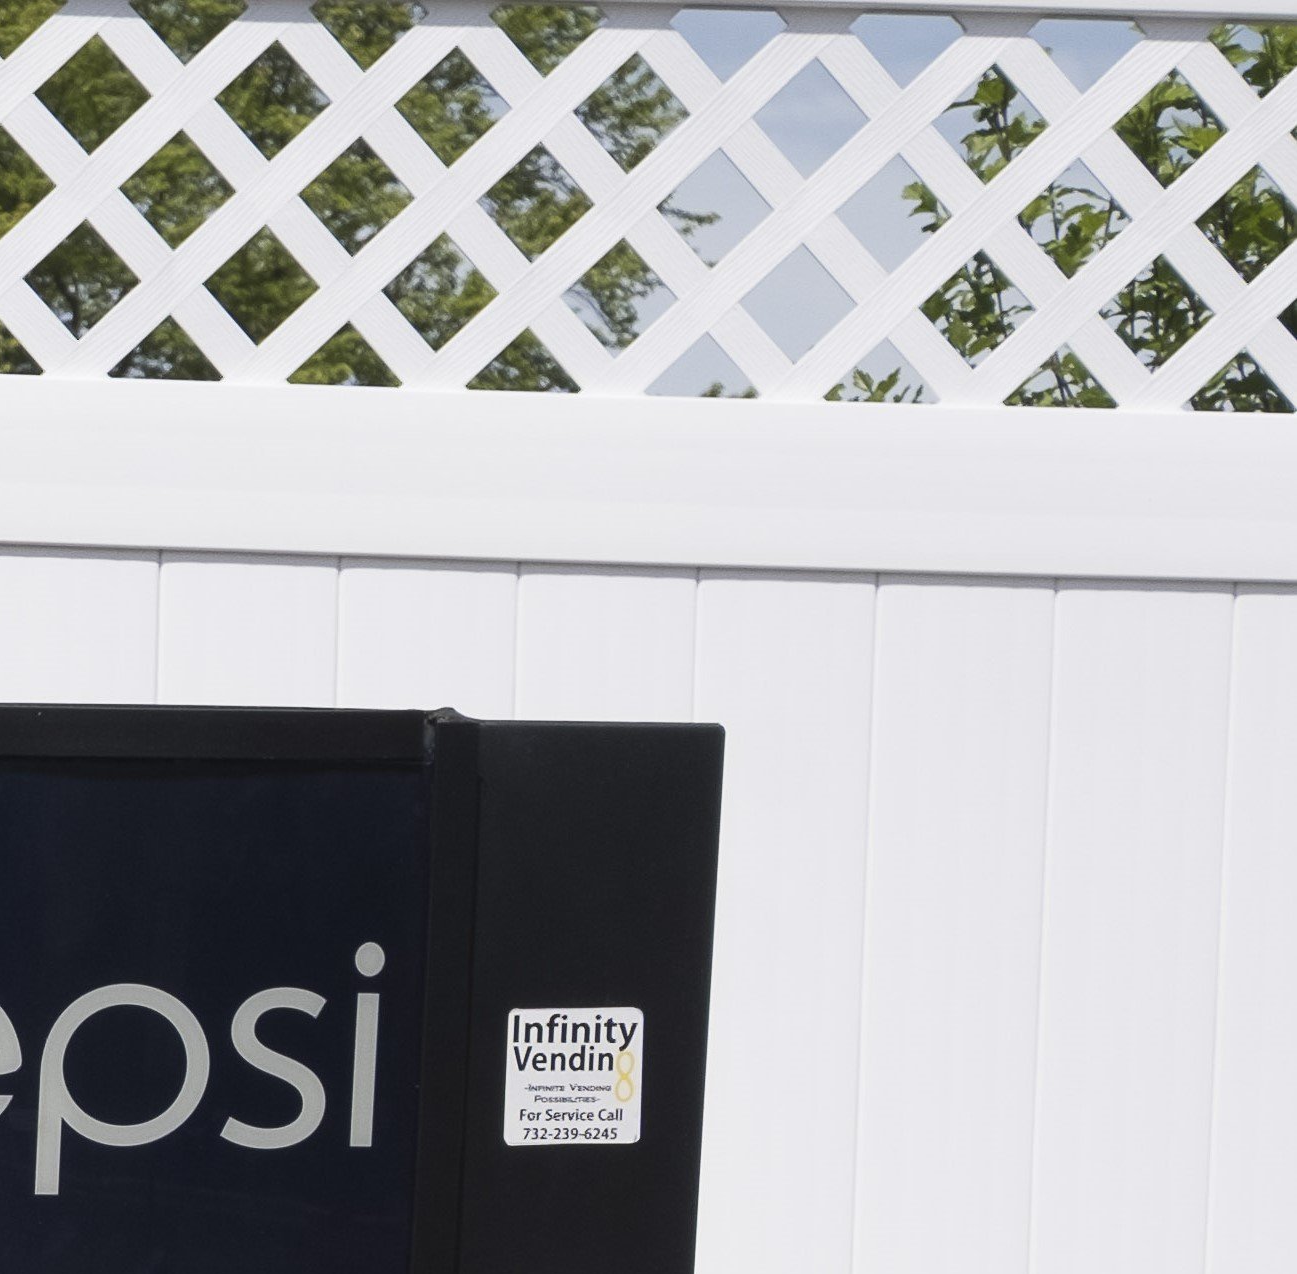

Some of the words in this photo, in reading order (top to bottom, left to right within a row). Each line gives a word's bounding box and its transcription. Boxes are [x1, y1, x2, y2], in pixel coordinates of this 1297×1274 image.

[513, 1013, 638, 1052] Infinity
[519, 1108, 541, 1121] For
[546, 1108, 594, 1121] Service
[598, 1108, 623, 1121] Call
[523, 1127, 618, 1140] 732-239-6245
